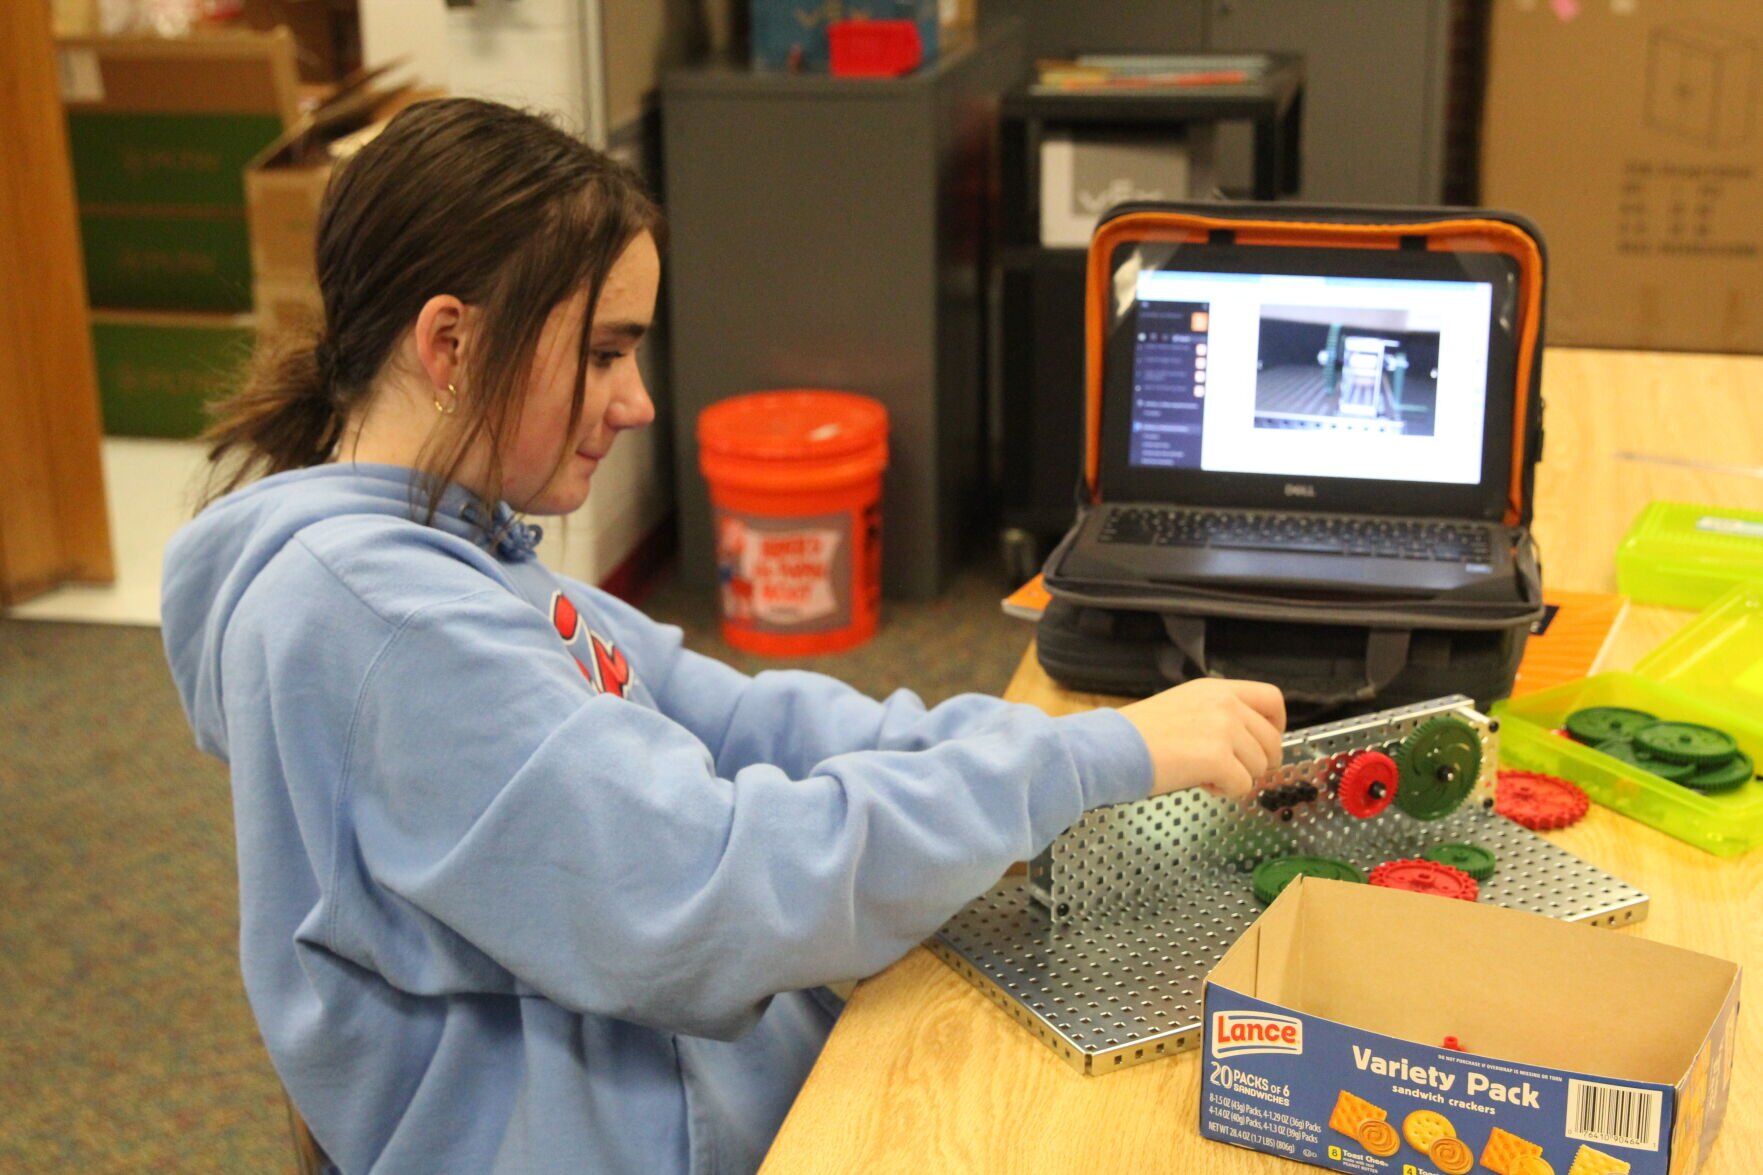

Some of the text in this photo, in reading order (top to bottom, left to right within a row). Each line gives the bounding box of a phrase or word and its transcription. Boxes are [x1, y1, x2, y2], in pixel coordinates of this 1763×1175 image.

[1217, 1015, 1297, 1044] Lance
[1210, 1061, 1290, 1097] 20 PACKS OF 6
[1352, 1045, 1540, 1109] Variety Pack
[1233, 1083, 1290, 1107] SANDWICHES
[1391, 1085, 1496, 1115] sandwich crackers
[1222, 1097, 1231, 1108] OZ
[1281, 1114, 1290, 1125] OZ
[1305, 1120, 1322, 1133] Packs
[1222, 1109, 1231, 1120] OZ
[1277, 1125, 1286, 1136] OZ
[1301, 1131, 1319, 1144] Packs
[1208, 1121, 1219, 1132] NET
[1219, 1123, 1229, 1135] WT
[1242, 1130, 1251, 1142] OZ
[1331, 1148, 1337, 1157] 8
